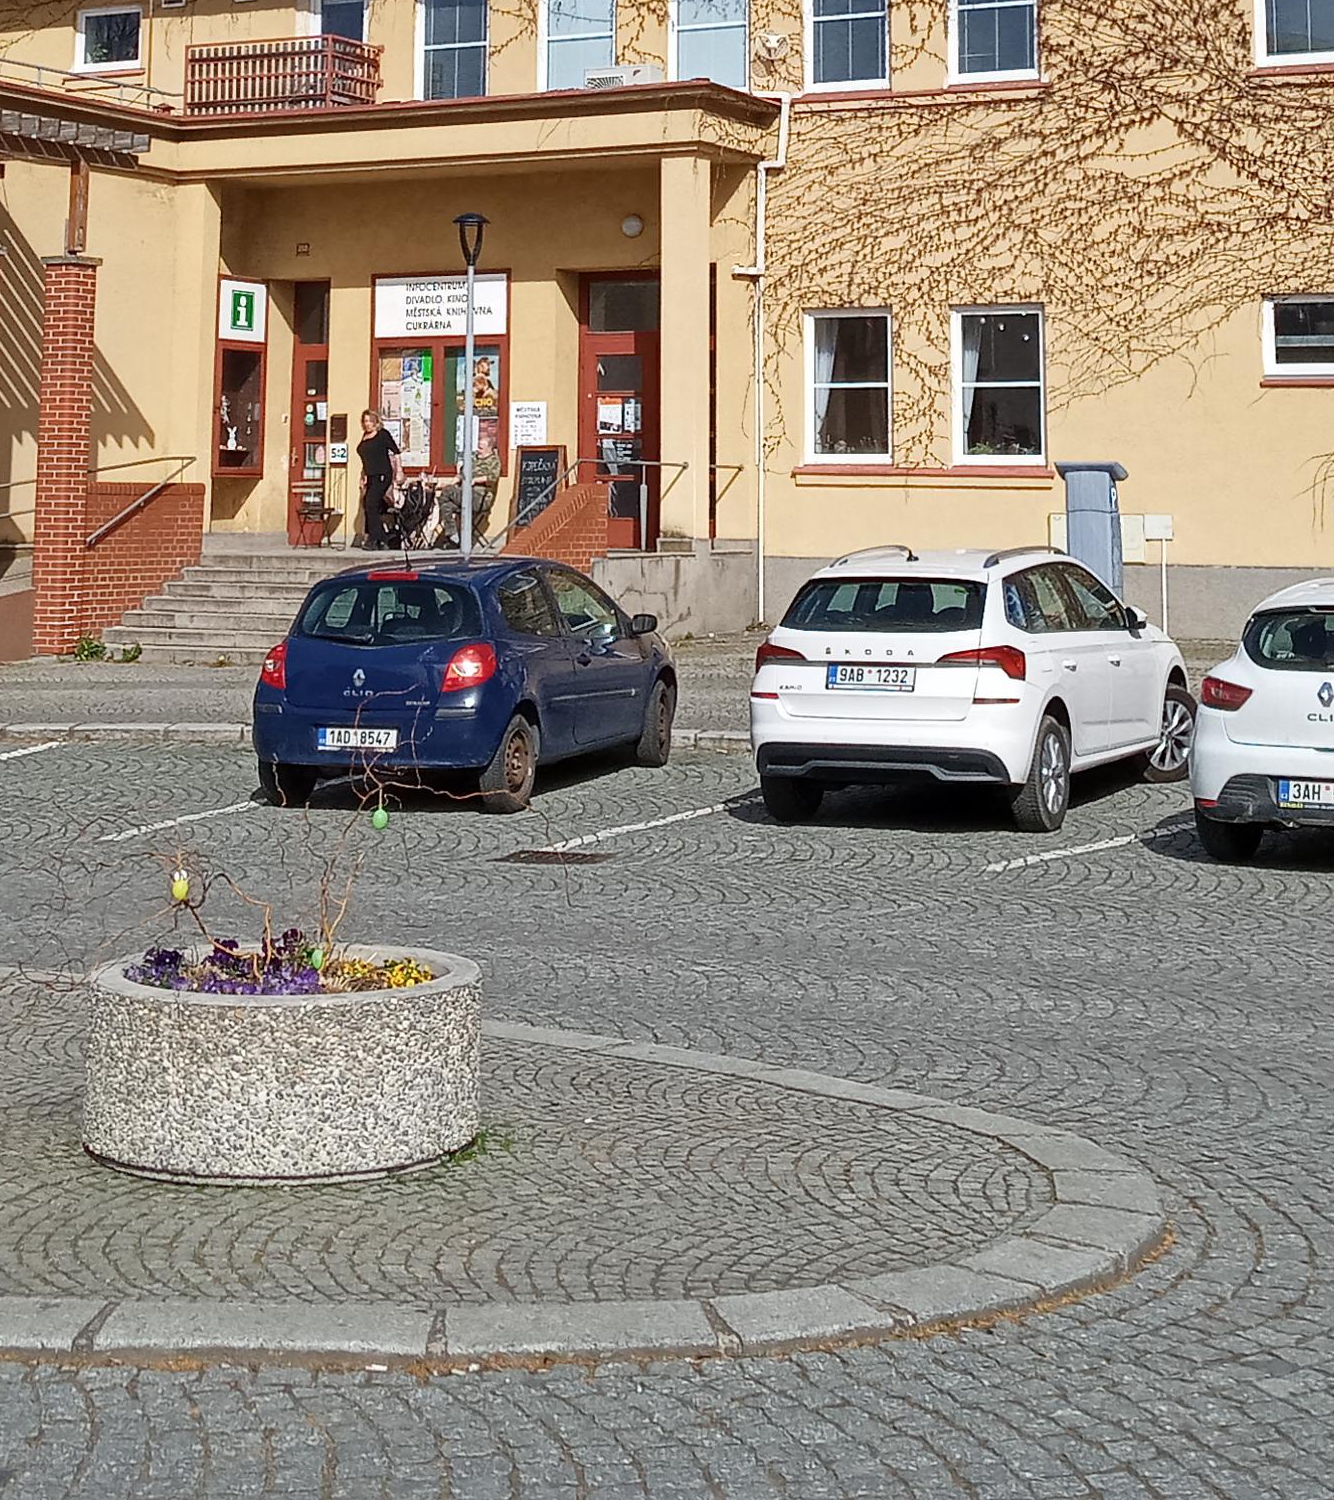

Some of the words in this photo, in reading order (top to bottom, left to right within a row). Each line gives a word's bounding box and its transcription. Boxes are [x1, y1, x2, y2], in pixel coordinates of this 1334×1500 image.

[447, 306, 493, 316] KNIHVNA
[839, 668, 864, 682] 9AB
[876, 669, 908, 683] 1232
[329, 730, 351, 743] 1AD
[360, 731, 391, 745] 8547
[1293, 783, 1321, 800] 3AH
